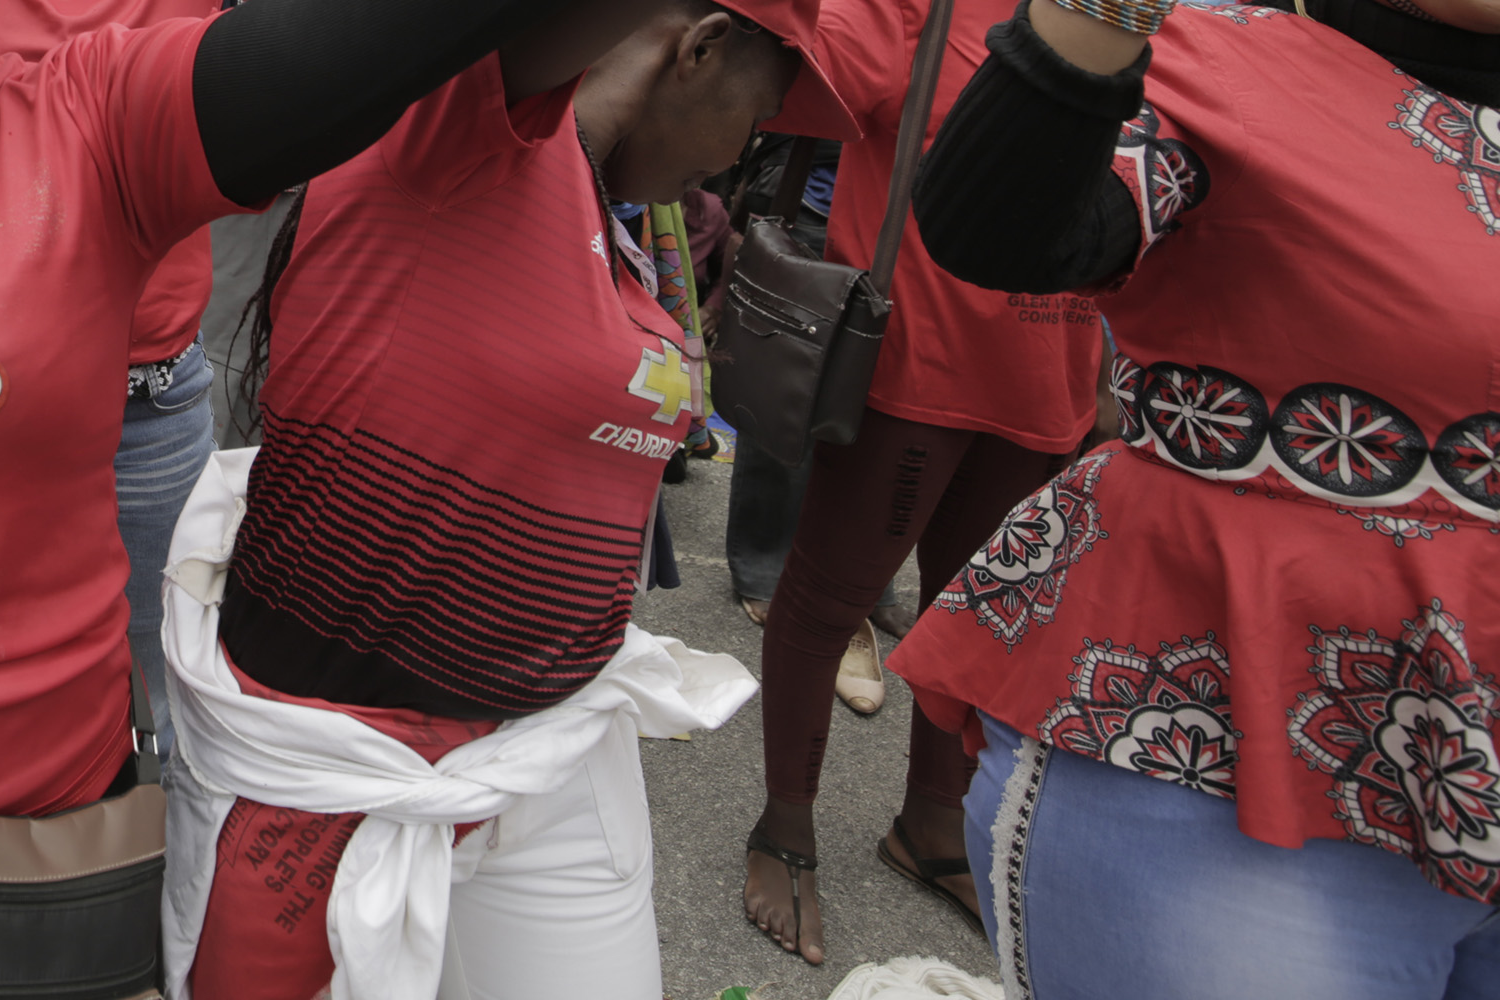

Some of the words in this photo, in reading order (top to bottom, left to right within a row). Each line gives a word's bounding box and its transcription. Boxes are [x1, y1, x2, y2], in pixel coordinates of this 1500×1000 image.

[1007, 295, 1050, 309] GLEN
[589, 422, 686, 461] CHEVROL
[274, 892, 316, 935] THE
